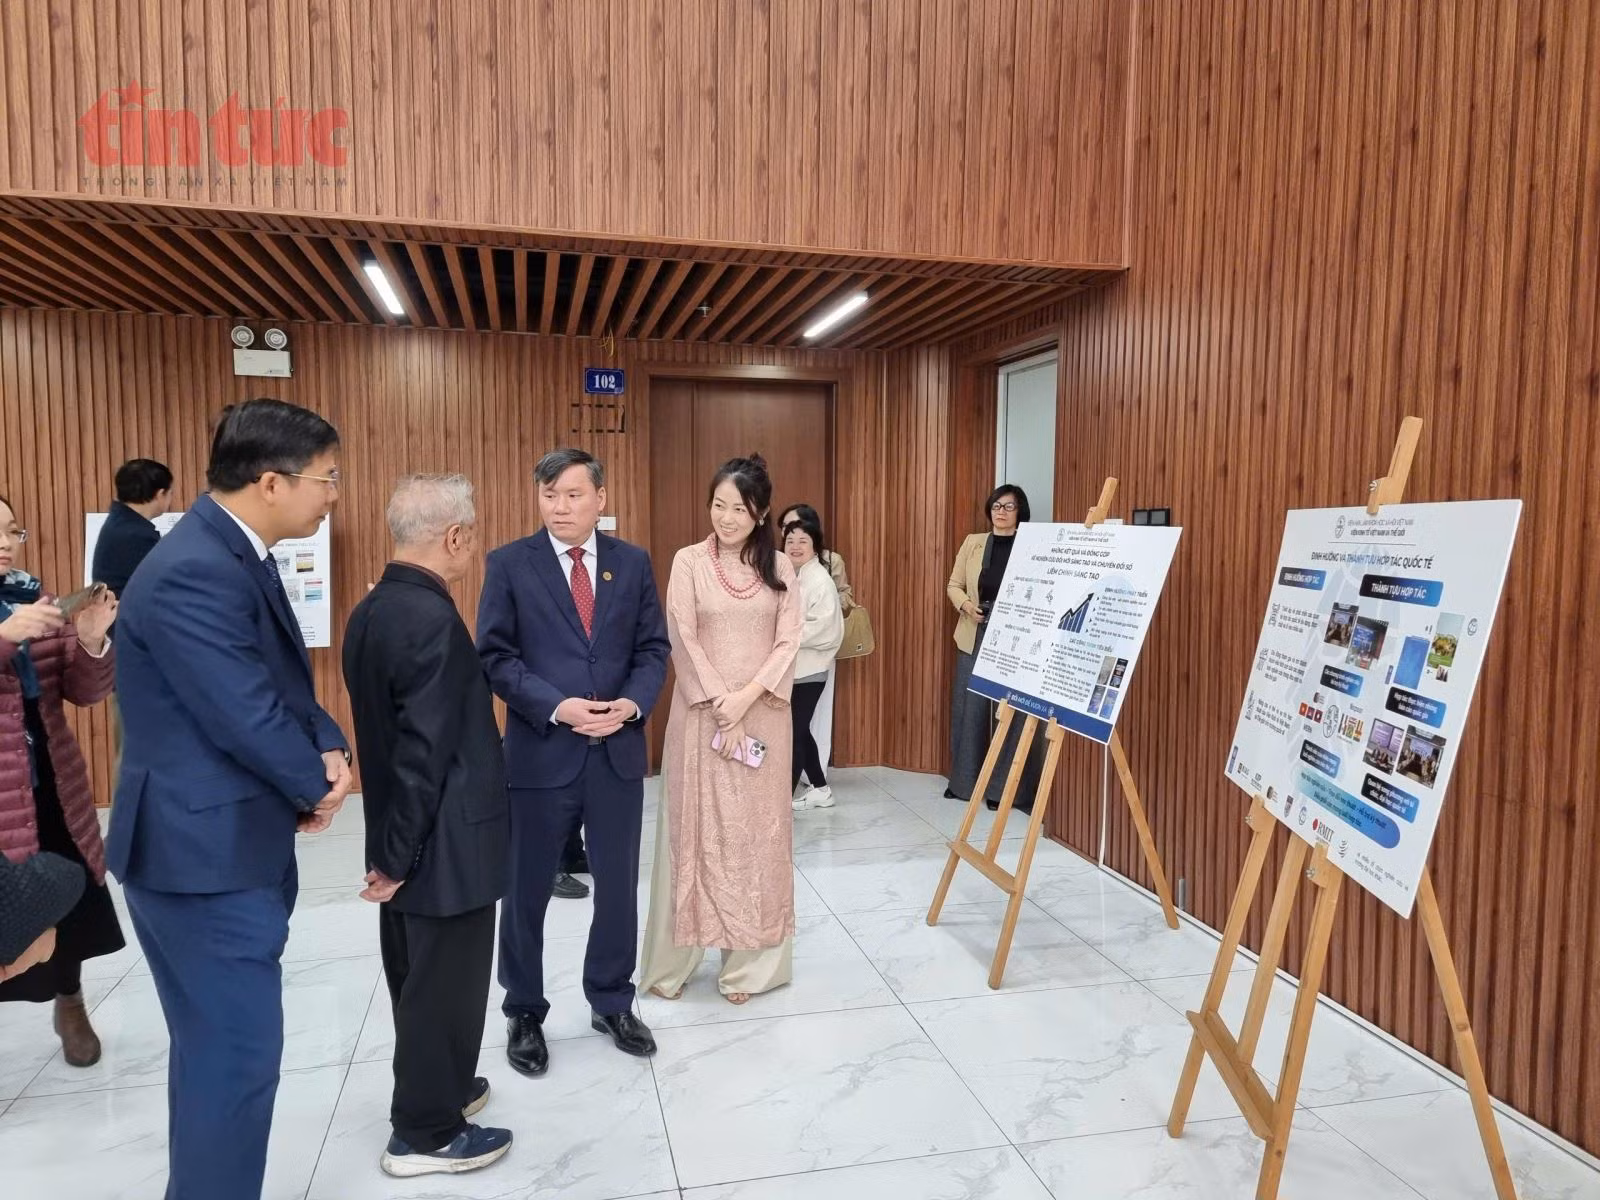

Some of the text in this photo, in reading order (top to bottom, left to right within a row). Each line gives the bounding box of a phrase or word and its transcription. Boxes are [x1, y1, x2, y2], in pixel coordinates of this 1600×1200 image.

[594, 374, 616, 389] 102
[1390, 554, 1402, 567] TÁC
[1403, 554, 1422, 569] QUỐC
[1424, 554, 1434, 569] TẾ
[1372, 580, 1426, 599] THÀNH TỰU HỢP TÁC
[1317, 822, 1334, 842] RMIT
